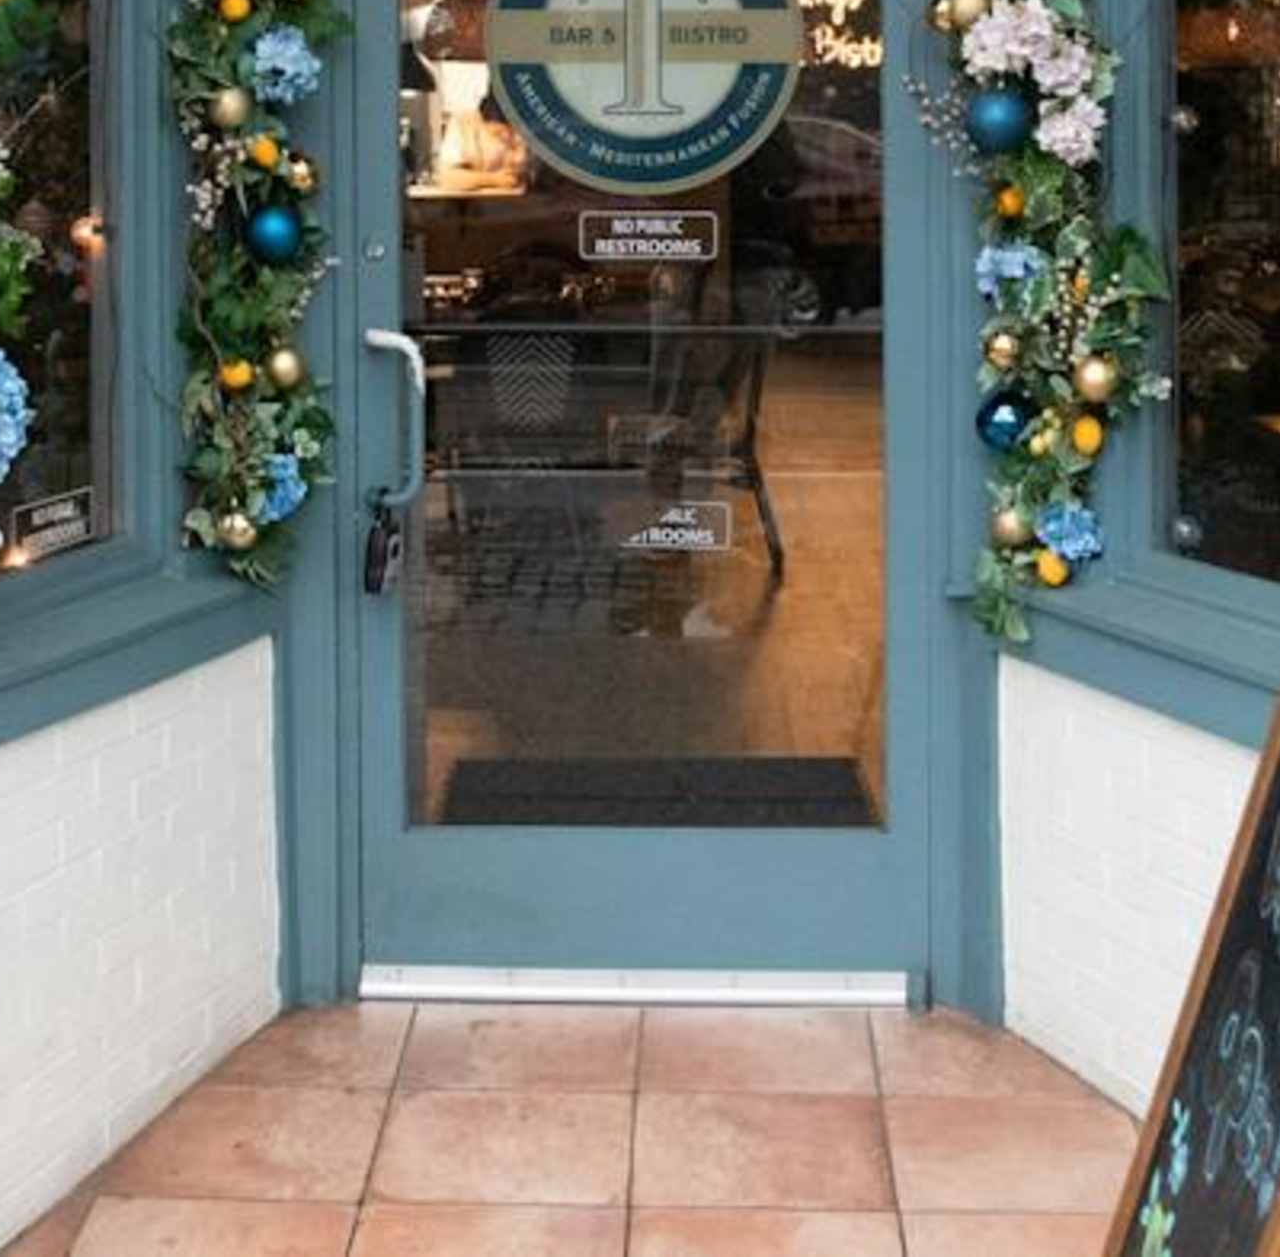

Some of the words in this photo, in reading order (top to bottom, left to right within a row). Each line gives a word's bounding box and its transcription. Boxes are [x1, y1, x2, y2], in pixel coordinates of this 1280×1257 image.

[549, 26, 593, 44] BAR
[670, 26, 749, 44] BISTRO
[514, 71, 577, 146] AMERICAN
[727, 71, 771, 131] FUSION
[611, 219, 634, 235] NO
[635, 218, 684, 235] PUBLIC
[594, 238, 702, 254] RESTROOMS
